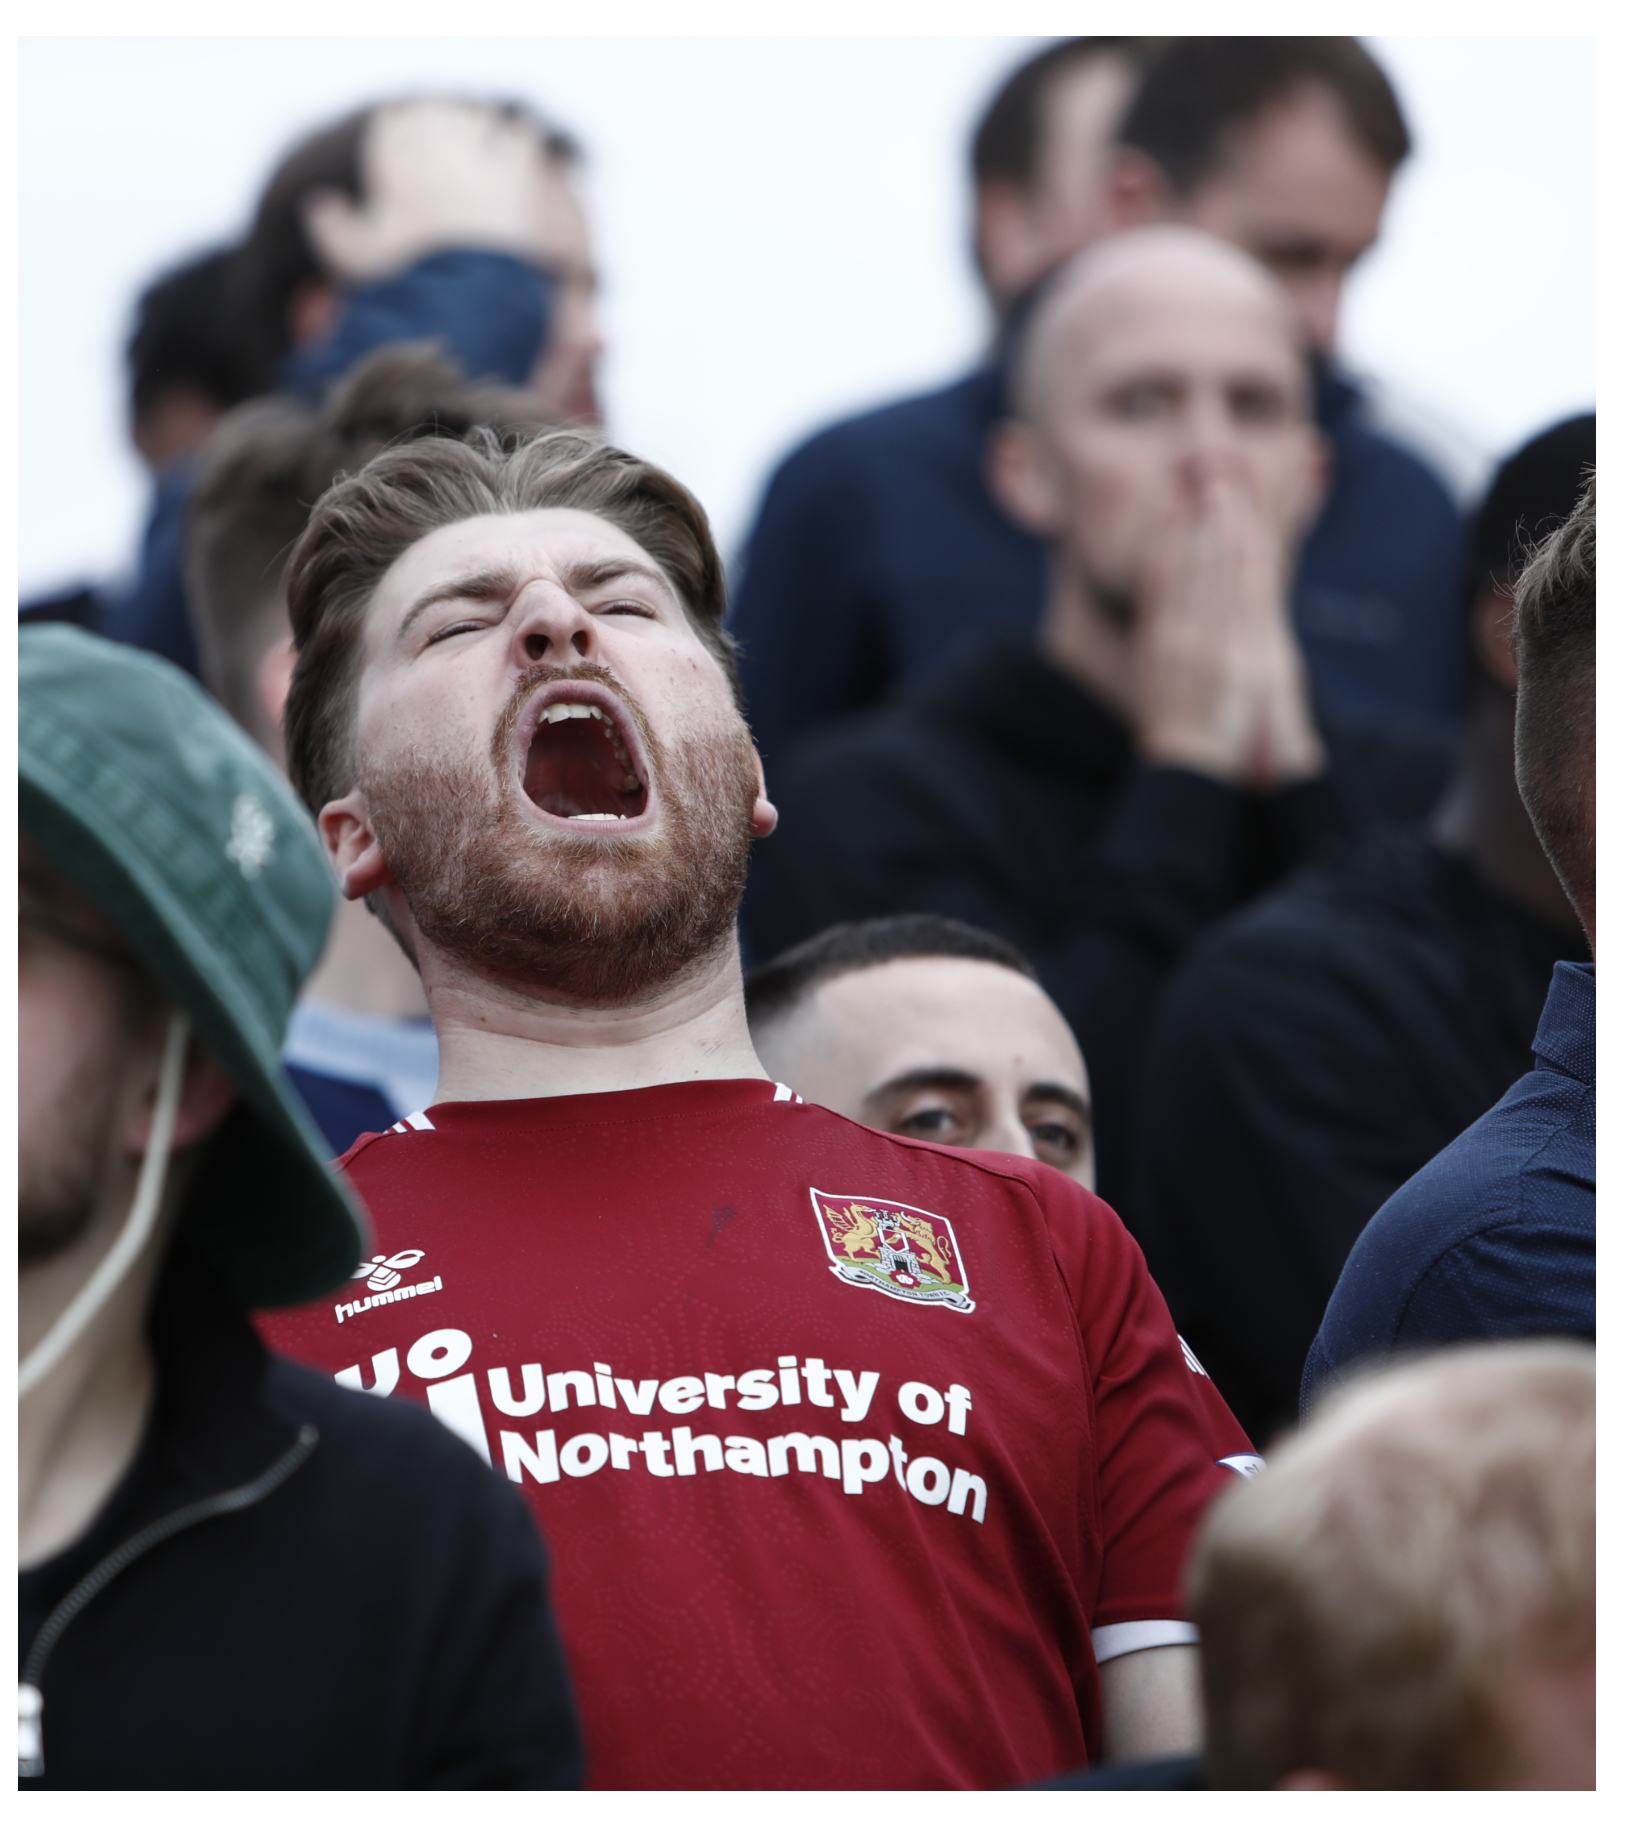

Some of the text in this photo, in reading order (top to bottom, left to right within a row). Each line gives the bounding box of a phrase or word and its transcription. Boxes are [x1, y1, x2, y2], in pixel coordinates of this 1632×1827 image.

[334, 1275, 444, 1324] hummel
[858, 1269, 919, 1297] NORTHAMPTON
[487, 1355, 973, 1436] University of
[499, 1425, 989, 1525] Northampton
